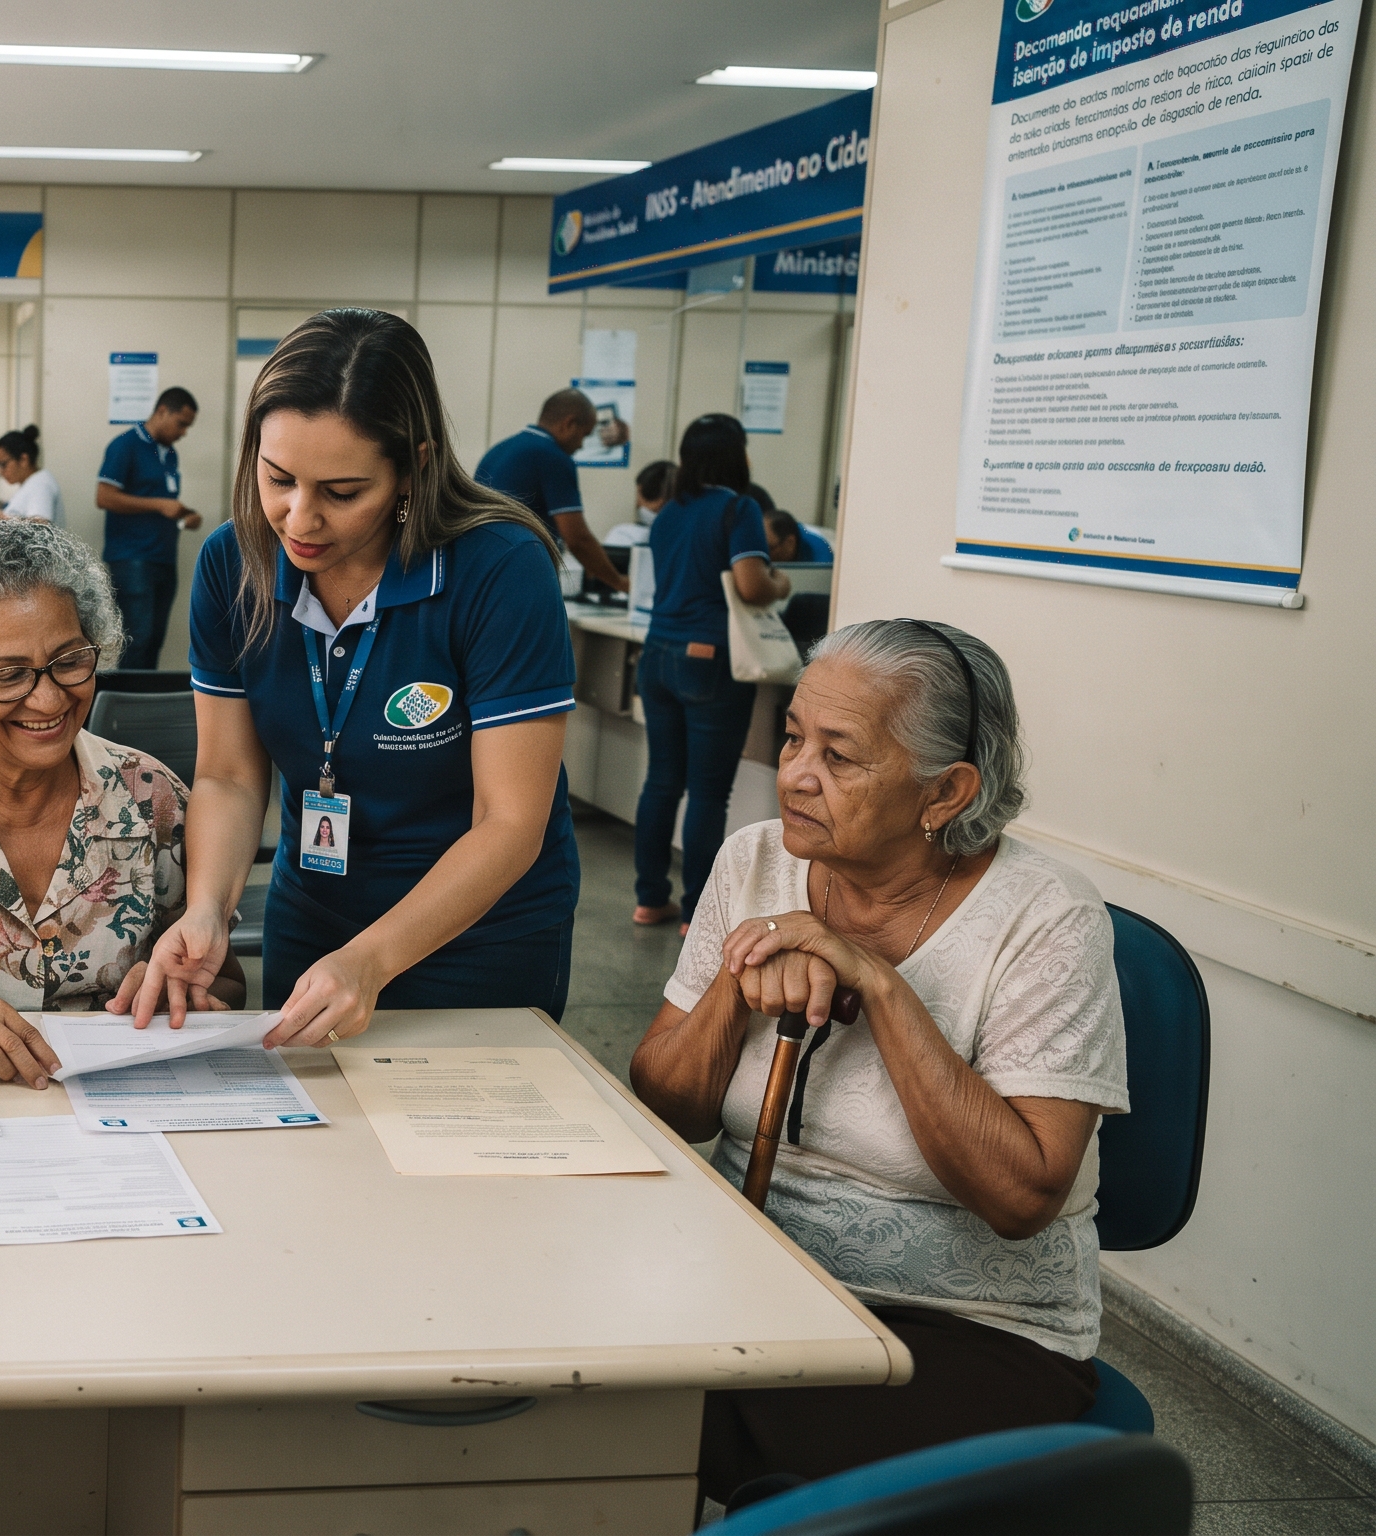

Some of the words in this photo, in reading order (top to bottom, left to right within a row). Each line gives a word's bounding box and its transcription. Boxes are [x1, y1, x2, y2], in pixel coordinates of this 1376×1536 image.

[1161, 14, 1183, 41] de
[1188, 0, 1243, 32] renda
[1317, 42, 1334, 60] de
[1208, 96, 1223, 111] de
[1224, 86, 1263, 107] renda.
[796, 152, 822, 181] ao
